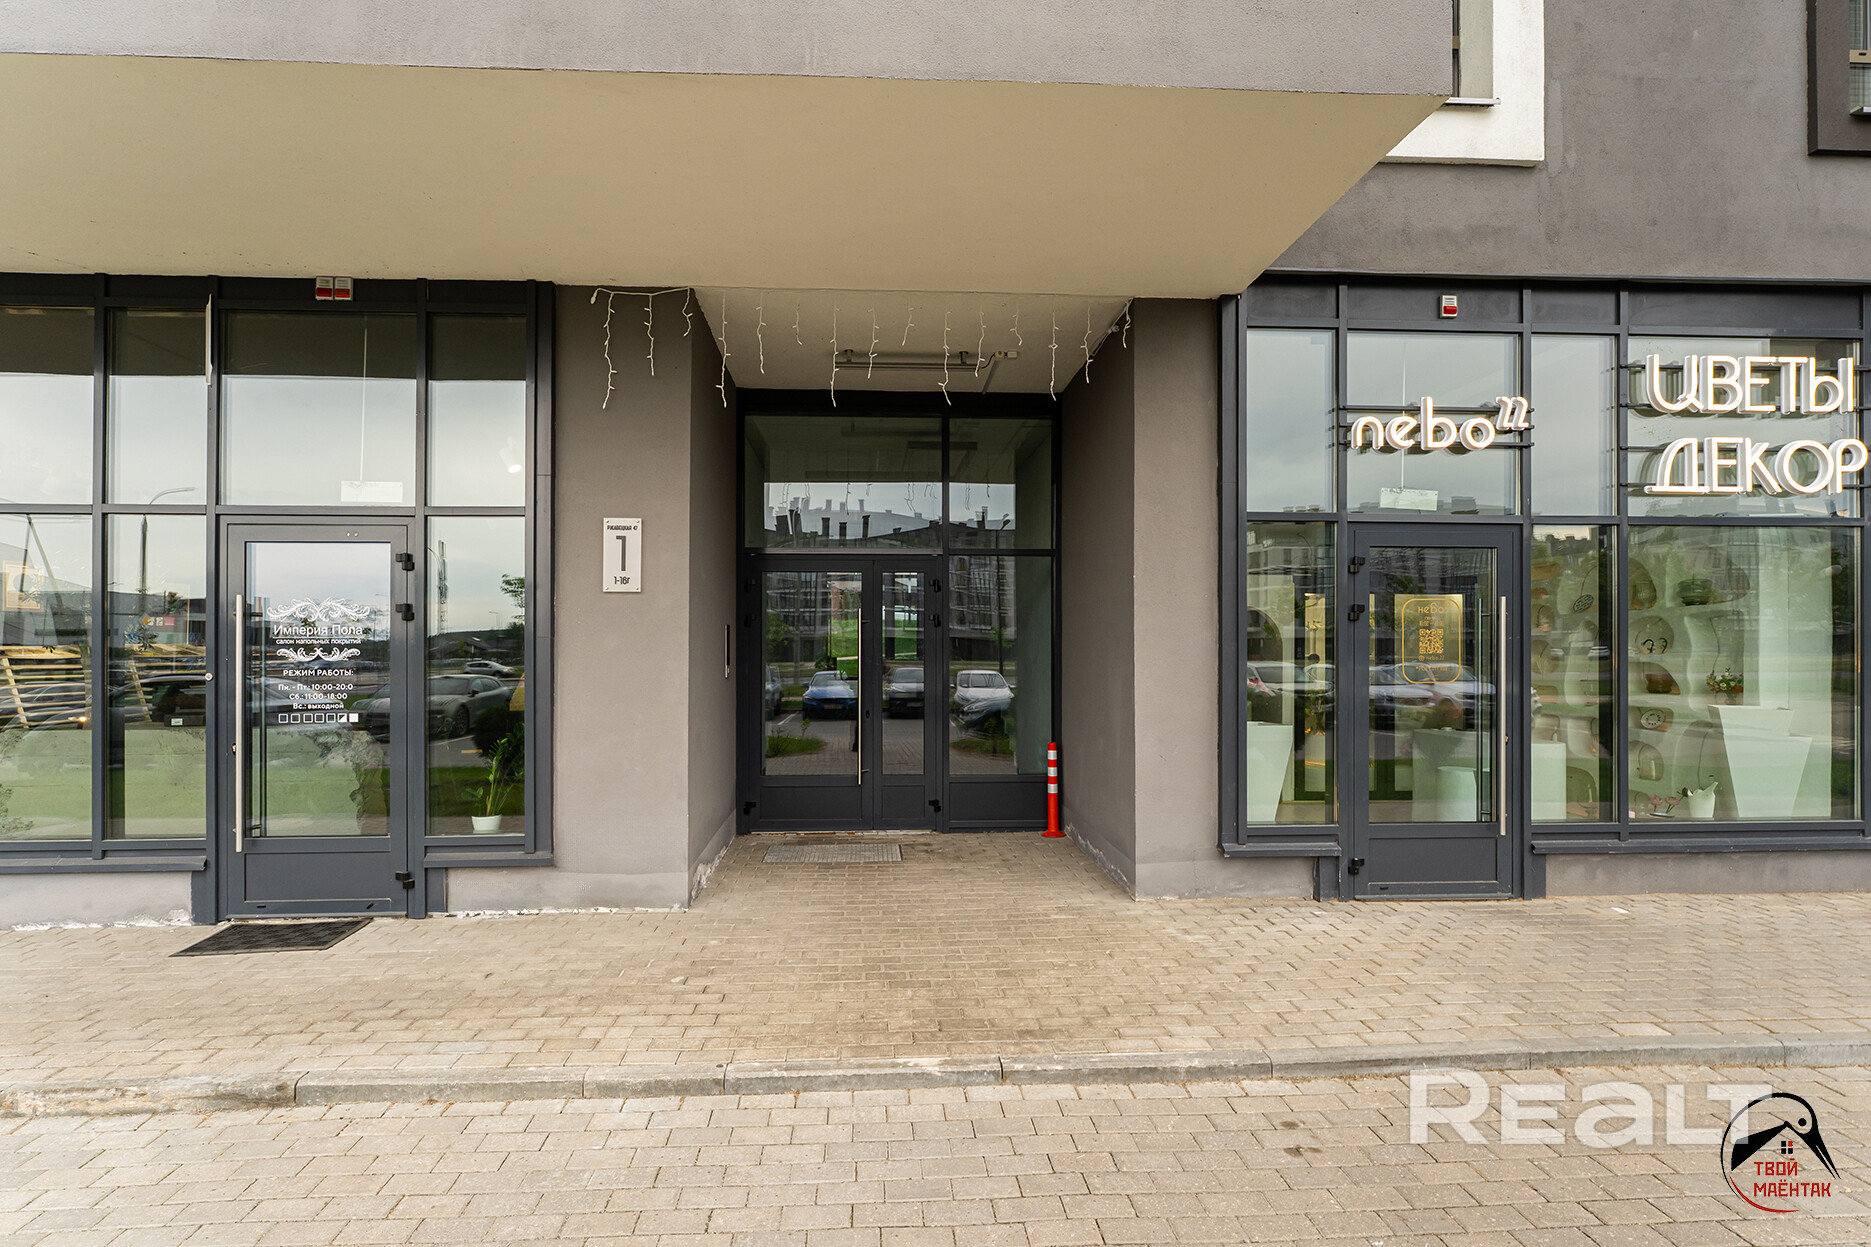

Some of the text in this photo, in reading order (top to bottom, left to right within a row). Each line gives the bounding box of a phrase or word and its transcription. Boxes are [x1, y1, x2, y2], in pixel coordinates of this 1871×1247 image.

[1646, 354, 1854, 415] ЦВЕТЫ
[1644, 437, 1868, 495] ДЕКОР
[616, 535, 626, 571] 1
[273, 624, 363, 637] Империя Пола
[308, 702, 344, 710] выходной
